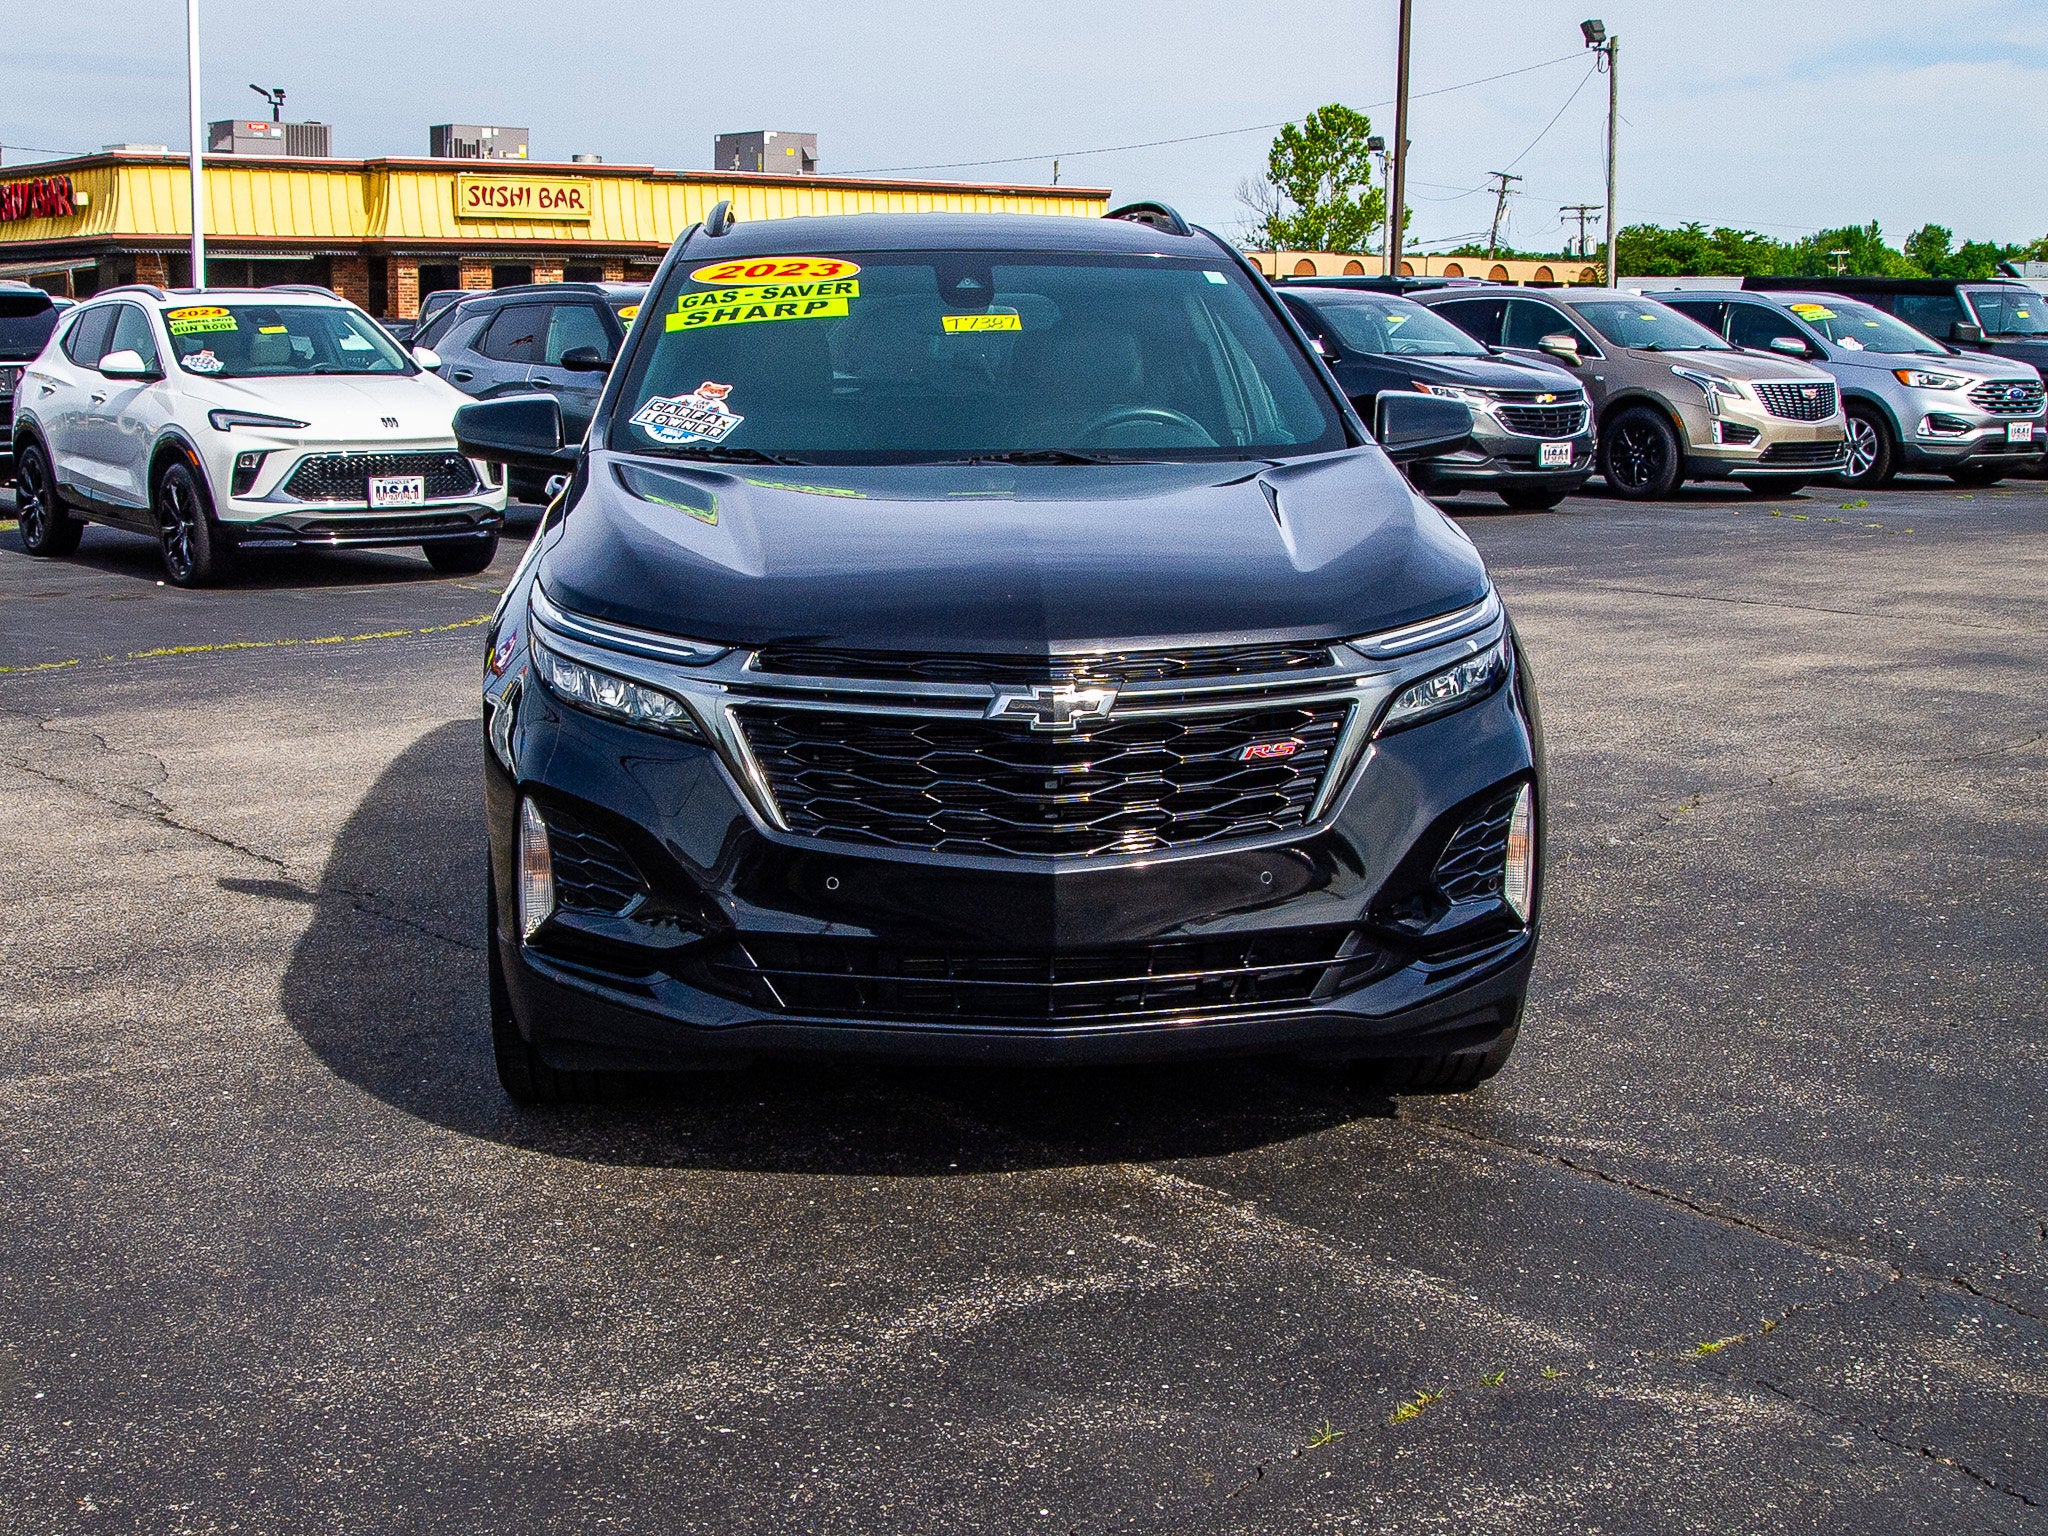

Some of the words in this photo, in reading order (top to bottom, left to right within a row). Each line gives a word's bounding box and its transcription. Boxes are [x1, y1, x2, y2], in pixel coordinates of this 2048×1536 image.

[32, 175, 74, 218] BAR
[468, 185, 531, 208] SUSHI
[538, 187, 585, 209] BAR
[710, 262, 843, 280] 2023
[682, 291, 739, 309] GAS
[760, 282, 853, 300] SAVER
[177, 309, 222, 318] 2024
[683, 301, 829, 327] SHARP
[174, 325, 198, 334] SUN
[650, 401, 730, 427] CARFAX
[652, 413, 726, 438] OWNER
[1544, 448, 1569, 461] USA1
[375, 485, 420, 501] USA1
[1239, 742, 1296, 760] RS
